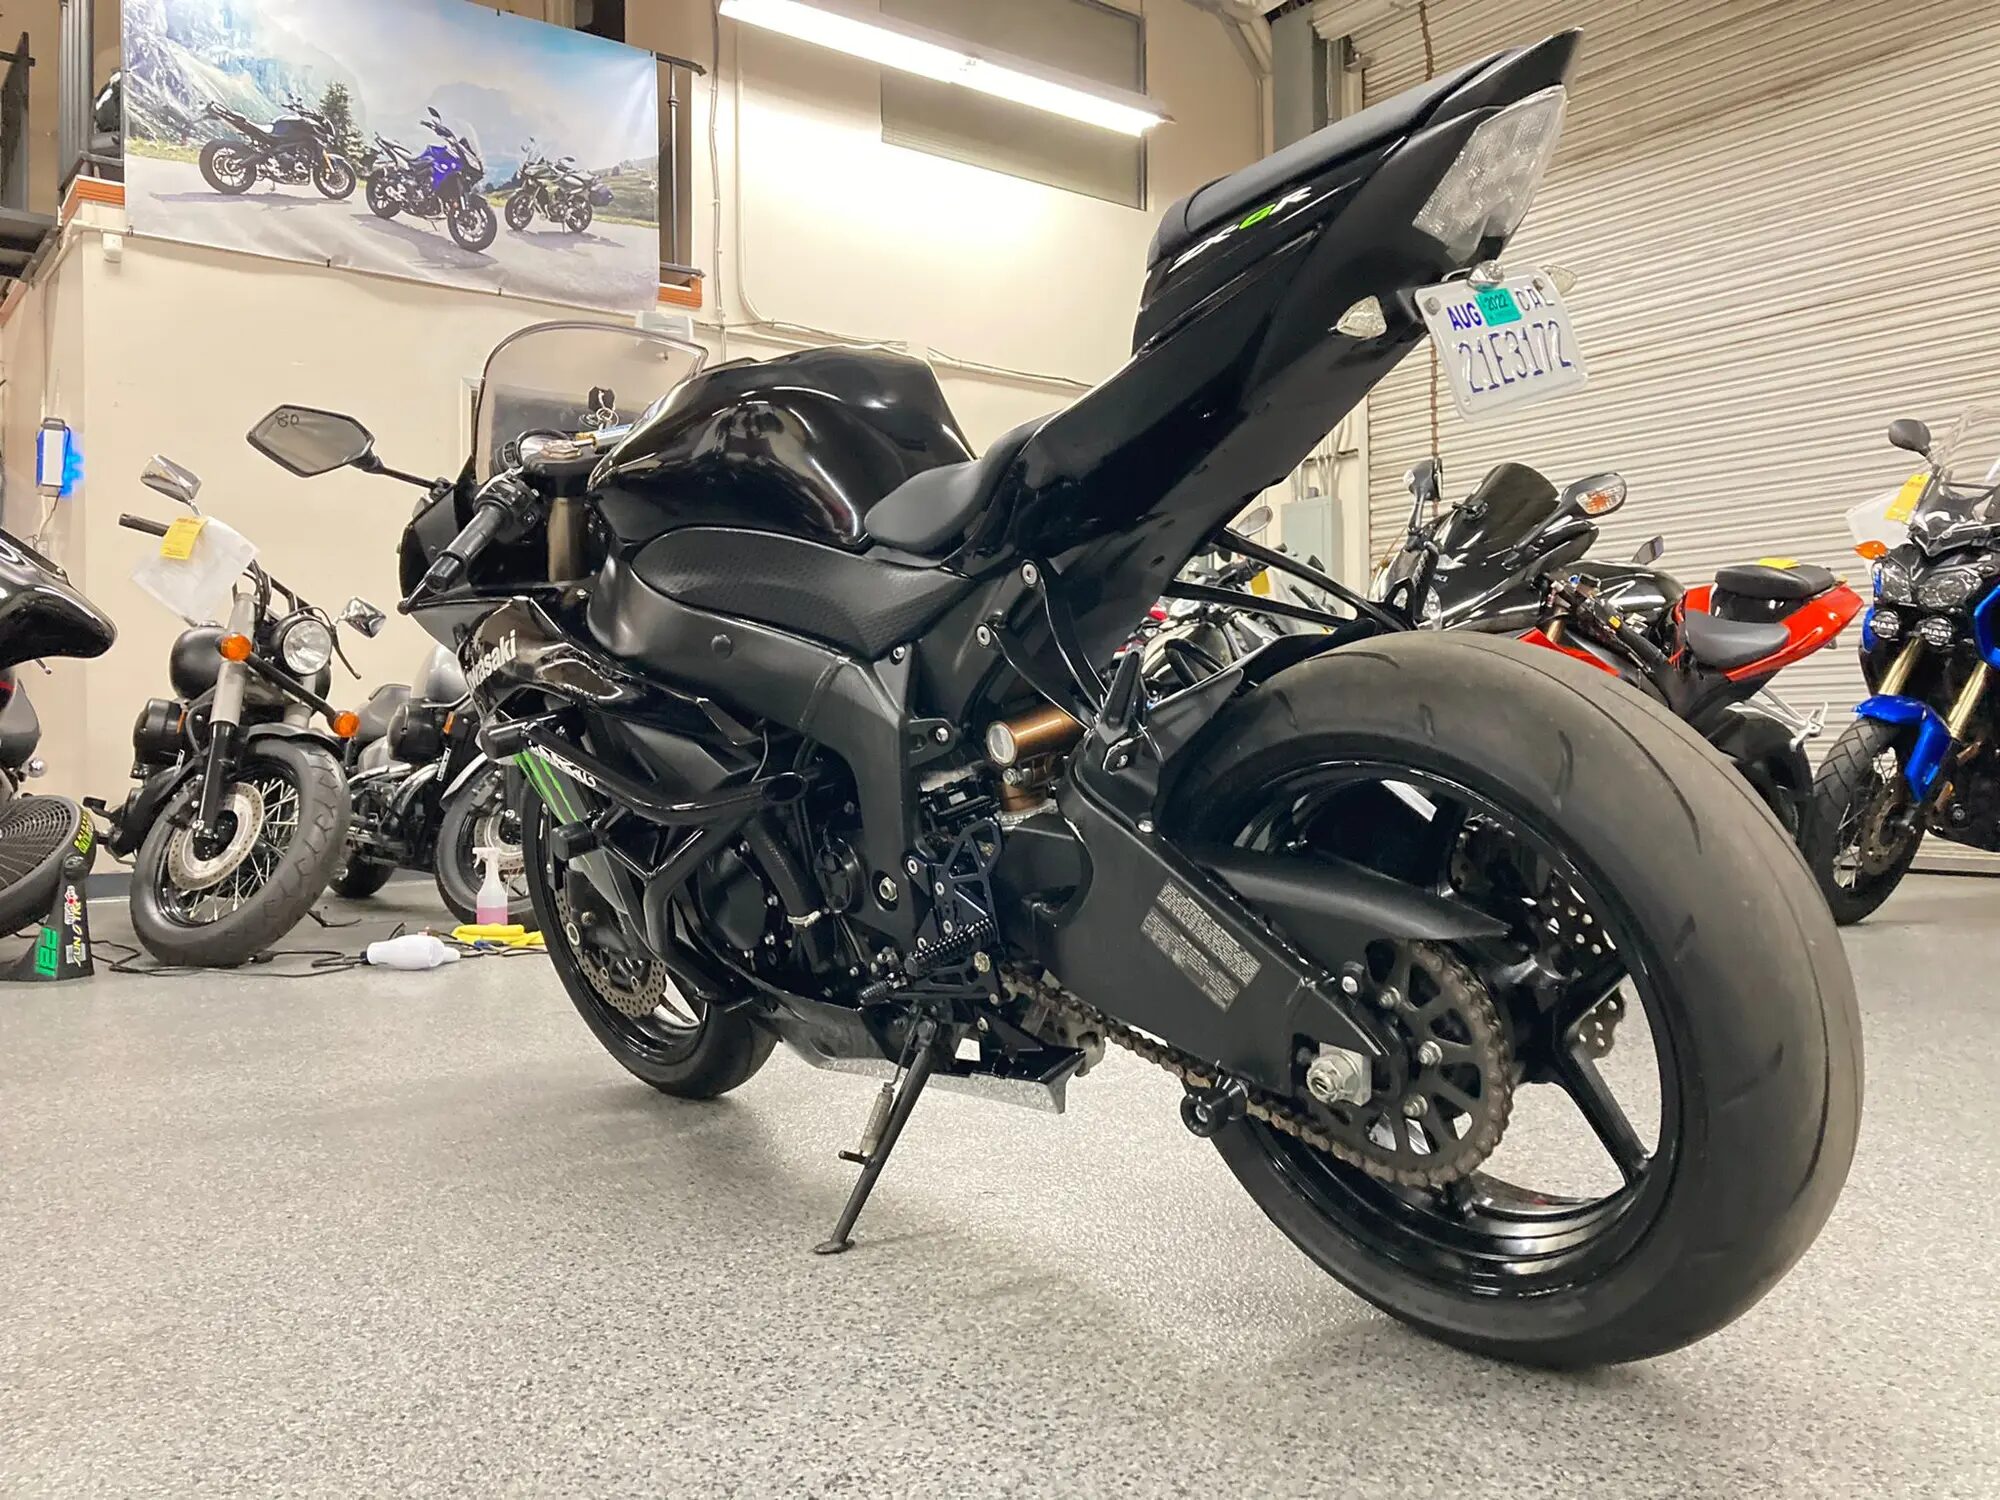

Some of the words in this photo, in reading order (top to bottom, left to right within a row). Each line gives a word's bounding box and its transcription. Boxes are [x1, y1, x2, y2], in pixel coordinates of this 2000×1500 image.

[1483, 293, 1509, 312] 2022
[1515, 284, 1555, 312] CAL
[1447, 301, 1483, 331] AUG
[1458, 319, 1573, 394] 21E3172
[467, 628, 517, 691] wasaki
